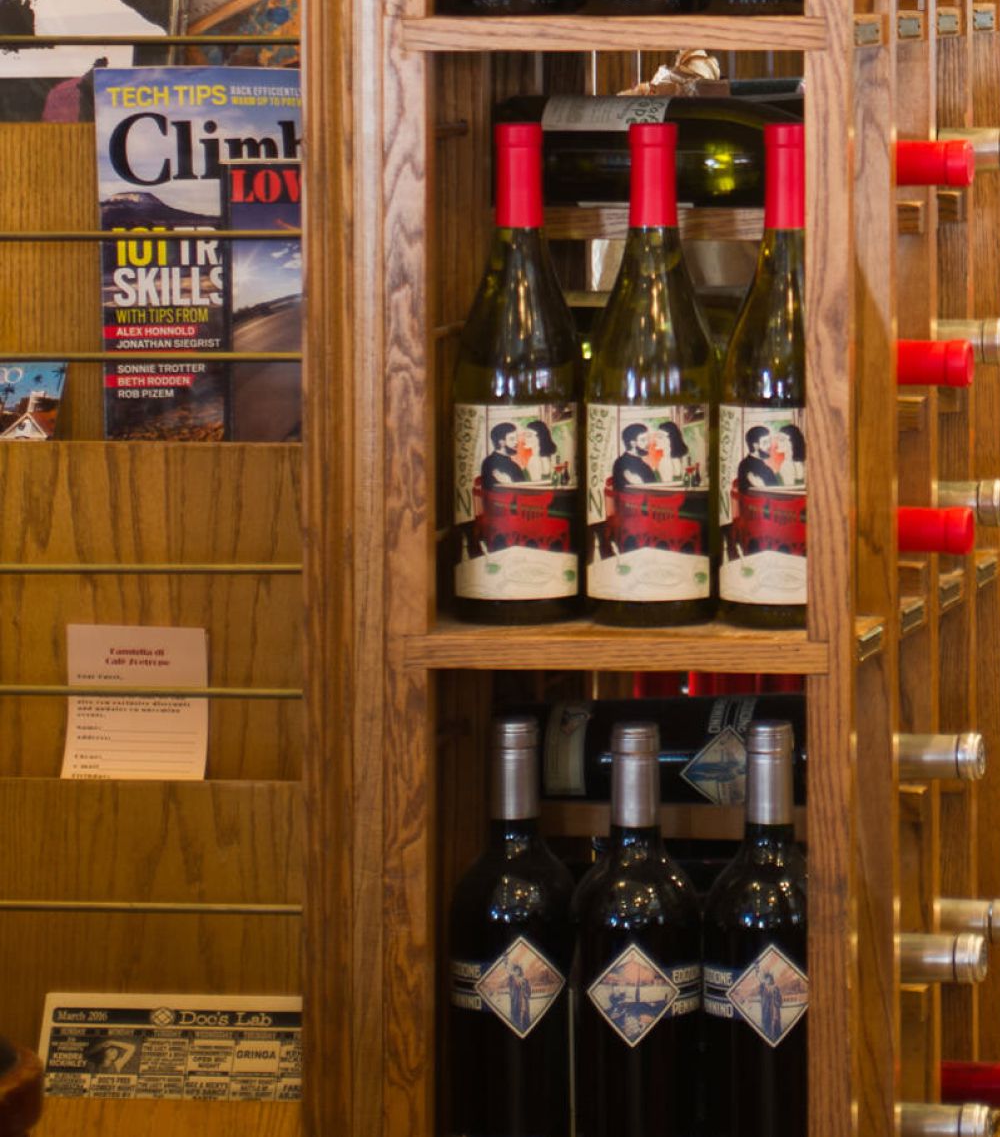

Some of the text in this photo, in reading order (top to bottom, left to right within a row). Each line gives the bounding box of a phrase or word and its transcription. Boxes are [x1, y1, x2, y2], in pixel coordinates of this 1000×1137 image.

[107, 85, 227, 108] TECH TIPS
[173, 226, 224, 265] TR
[113, 267, 224, 307] SKILLS
[116, 308, 209, 324] WITH TIPS FROM
[116, 326, 195, 336] ALEX HONNOLD
[116, 338, 221, 349] JONATHAN SIEGRIST
[117, 363, 206, 374] SONNIE TROTTER
[118, 376, 190, 387] BETH RODDEN
[118, 388, 175, 399] ROB PIZEM
[180, 1011, 230, 1026] Doc's
[235, 1012, 273, 1026] Lab
